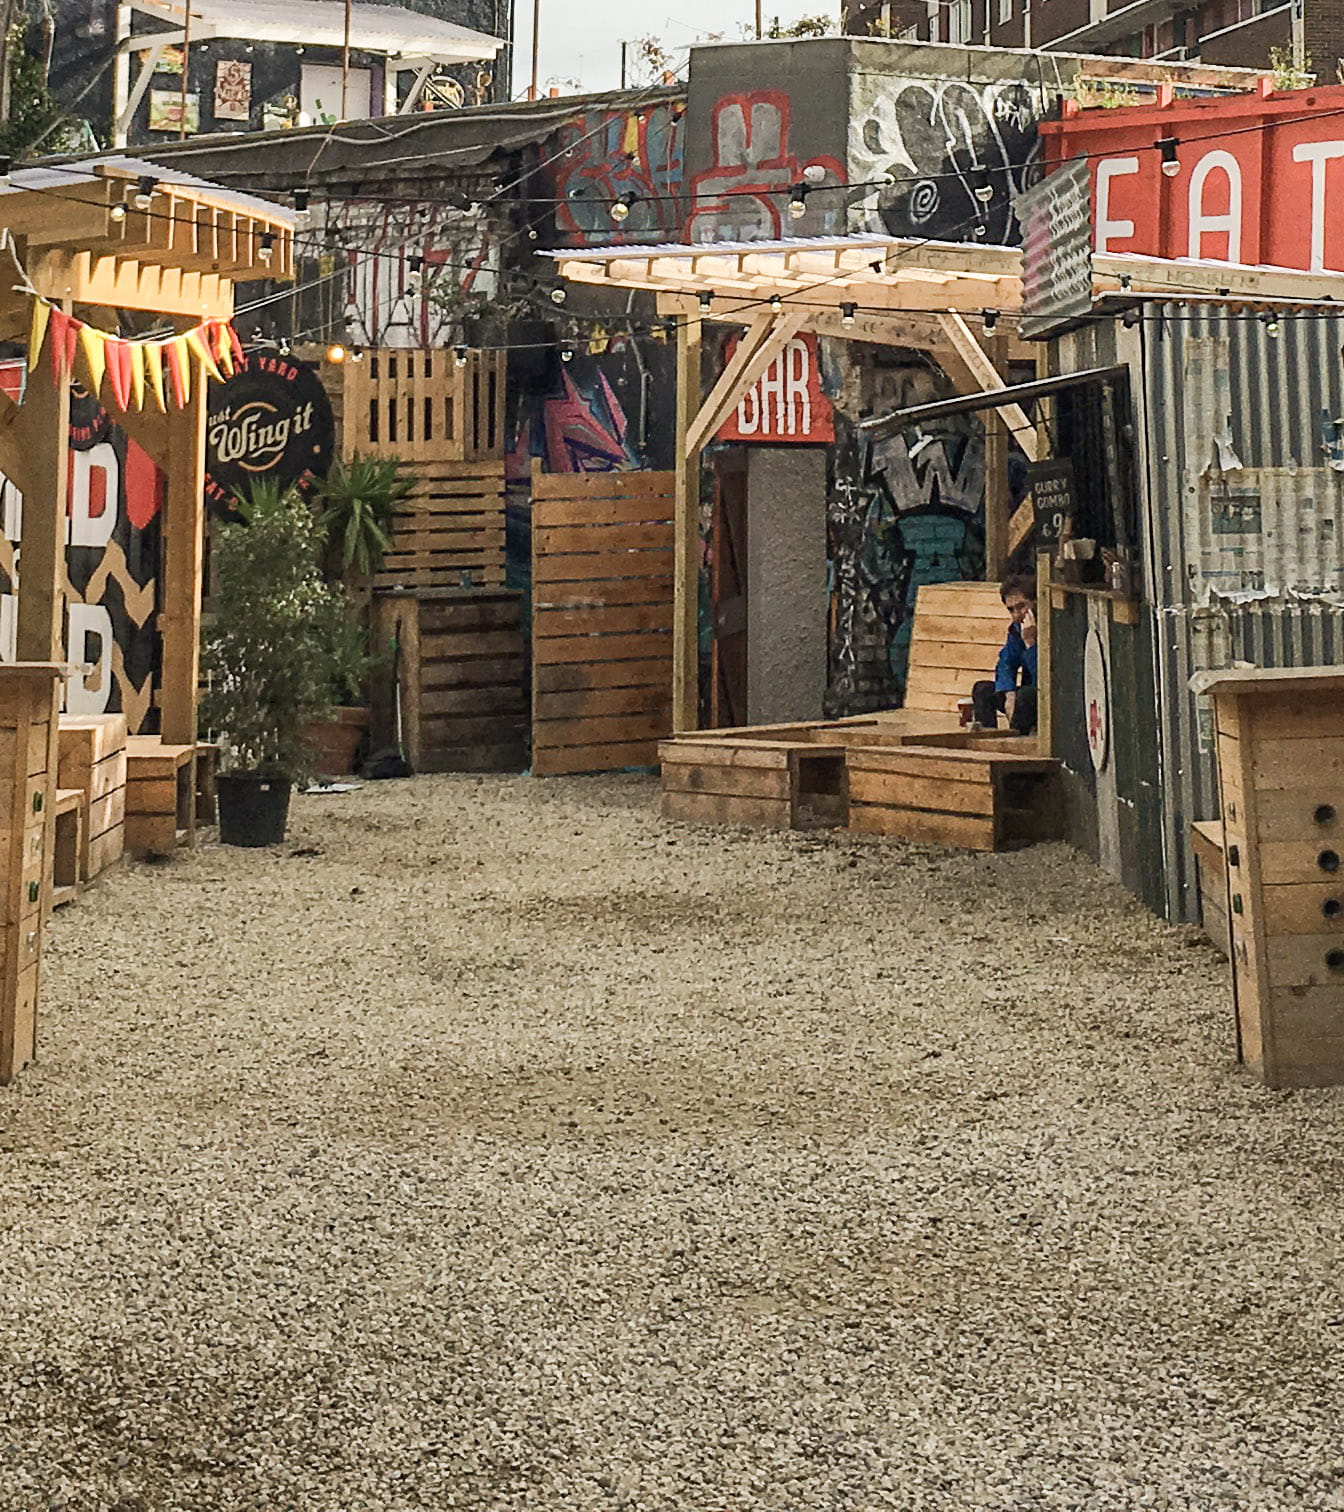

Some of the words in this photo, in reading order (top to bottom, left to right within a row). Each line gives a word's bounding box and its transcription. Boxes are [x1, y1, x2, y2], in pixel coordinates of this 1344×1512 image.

[258, 357, 299, 381] YARD
[208, 405, 231, 427] ust
[209, 412, 291, 463] Wing
[294, 401, 314, 434] it
[1035, 478, 1067, 494] CURRY
[1037, 493, 1070, 510] COMBO
